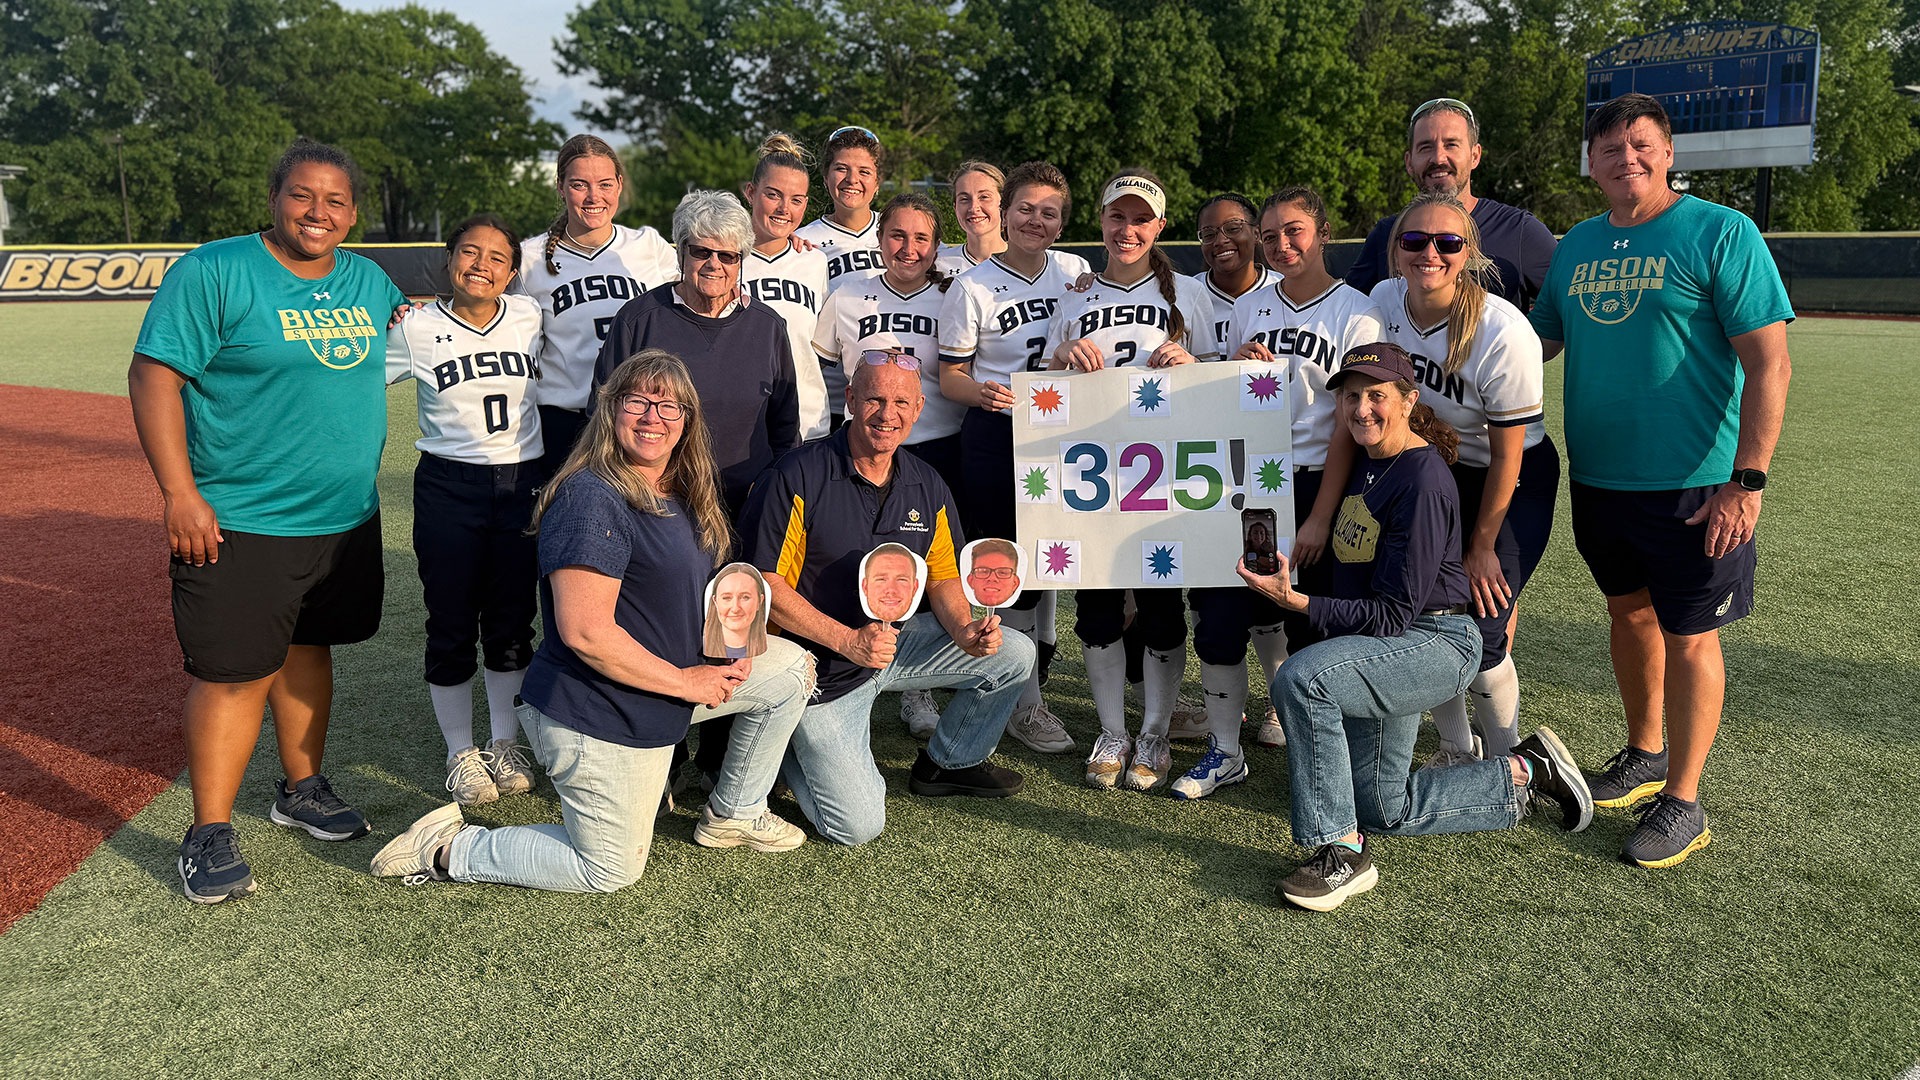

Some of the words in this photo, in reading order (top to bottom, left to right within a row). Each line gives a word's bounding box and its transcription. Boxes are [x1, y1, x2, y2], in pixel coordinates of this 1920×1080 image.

[1619, 25, 1778, 61] GALLAUDET
[1786, 52, 1804, 63] H/E
[1115, 180, 1158, 197] GALLAUDET
[1, 256, 180, 290] BISON
[1571, 256, 1667, 285] BISON
[742, 278, 816, 315] ISON
[1572, 280, 1653, 294] SOFTBALL
[277, 306, 373, 330] BISON
[293, 326, 373, 339] SOFTBALL
[858, 313, 938, 342] BISO
[433, 351, 541, 393] BISON
[1344, 353, 1381, 367] Bison
[1408, 352, 1465, 406] SON
[483, 394, 508, 434] 0
[1063, 438, 1245, 512] 325!
